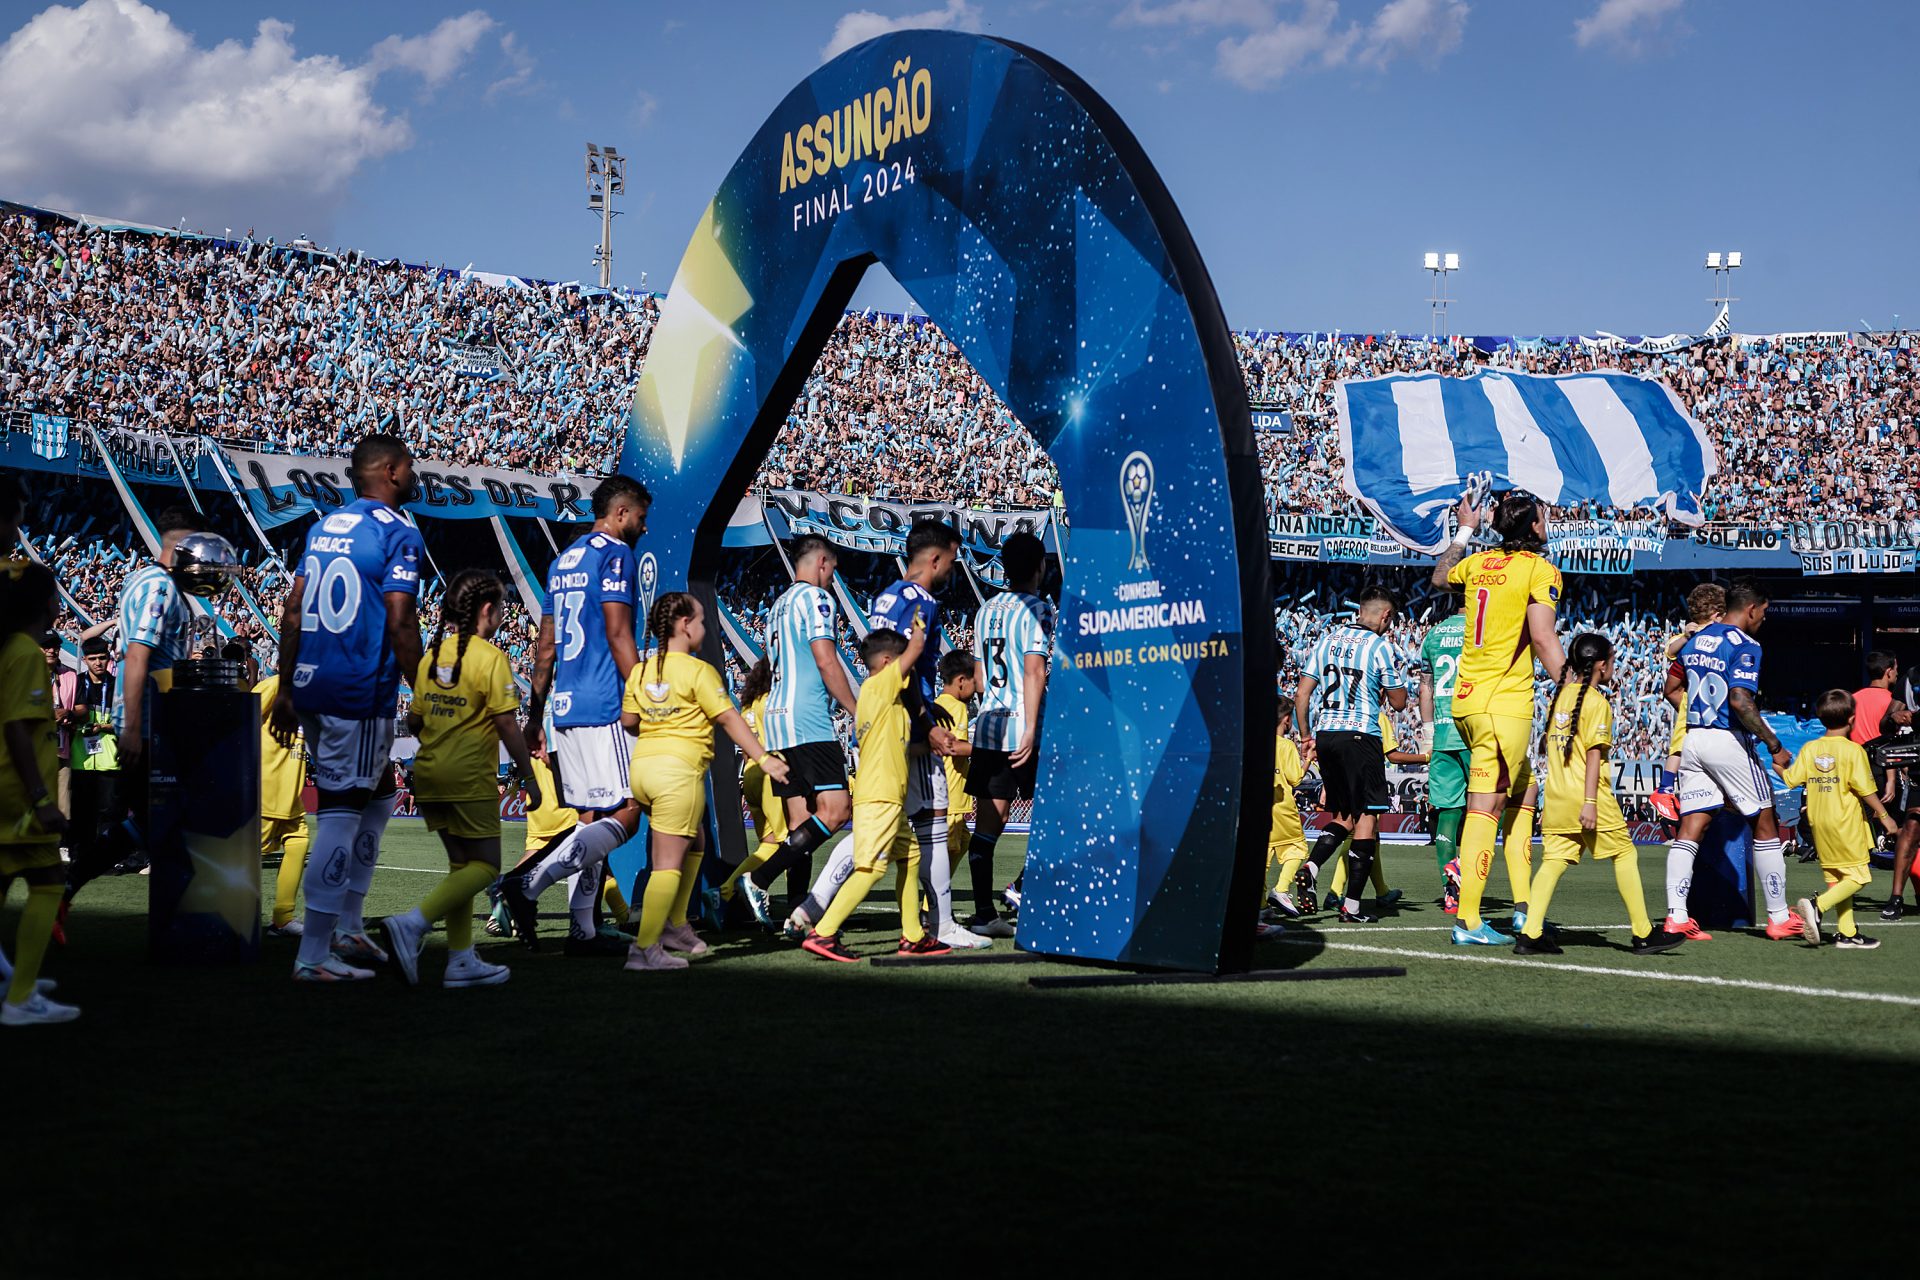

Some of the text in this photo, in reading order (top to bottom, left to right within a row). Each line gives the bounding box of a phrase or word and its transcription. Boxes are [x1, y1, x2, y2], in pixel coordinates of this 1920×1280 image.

[780, 56, 931, 194] ASSUNÇÃO
[794, 156, 915, 232] FINAL 2024
[34, 413, 67, 424] RACNG
[1251, 415, 1282, 428] LIDA
[248, 460, 344, 512] LOS
[481, 477, 538, 508] DE
[1307, 516, 1373, 536] NORTE
[1547, 524, 1565, 540] LOS
[1569, 521, 1594, 537] PIBES
[311, 536, 354, 554] WALACE
[1696, 529, 1777, 548] SOLANO
[1297, 544, 1319, 557] PAZ
[1327, 541, 1369, 557] CASEROS
[1370, 544, 1400, 553] BELGRANO
[1804, 556, 1831, 571] SOS
[301, 555, 361, 633] 20
[1119, 581, 1162, 601] CONMEBOL
[1079, 599, 1206, 636] SUDAMERICANA
[1475, 587, 1490, 648] 1
[1792, 606, 1837, 614] EMERGENCIA
[1440, 636, 1463, 647] ARIAS
[1061, 640, 1229, 669] A GRANDE CONQUISTA
[1330, 645, 1354, 659] ROJAS
[983, 638, 1008, 688] 13
[294, 669, 311, 683] BH
[1322, 664, 1363, 710] 27
[555, 700, 568, 711] BH
[1687, 669, 1728, 726] 29
